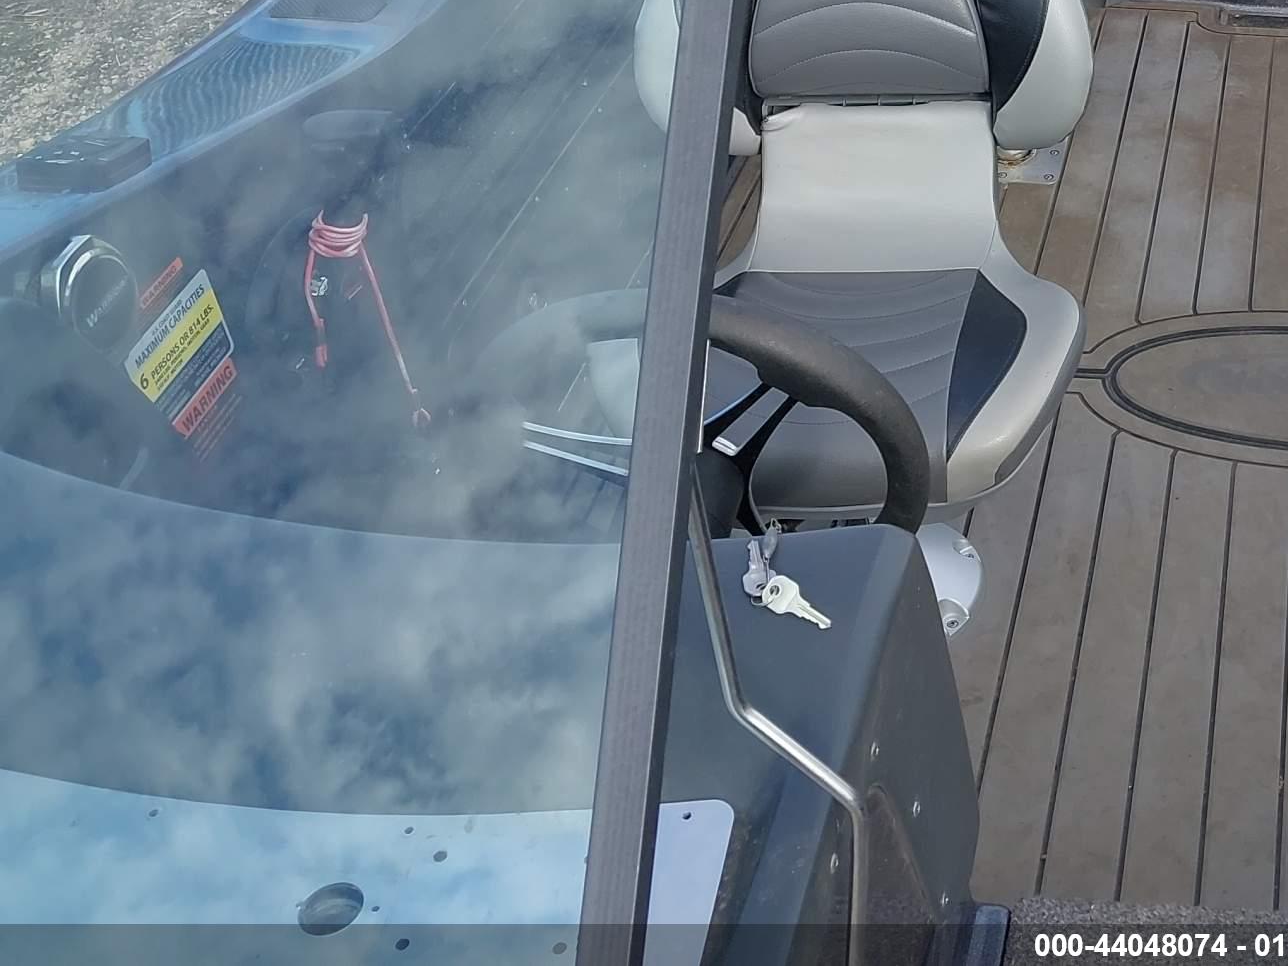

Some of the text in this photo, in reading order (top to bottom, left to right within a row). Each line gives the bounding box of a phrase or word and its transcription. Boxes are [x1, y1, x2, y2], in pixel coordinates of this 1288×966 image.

[134, 324, 171, 369] MAXIMUM
[167, 283, 206, 329] CAPACITIES
[140, 372, 150, 390] 6
[150, 343, 181, 380] PERSONS
[179, 331, 191, 346] OR
[199, 303, 215, 321] LBS.
[181, 365, 234, 432] WARNING
